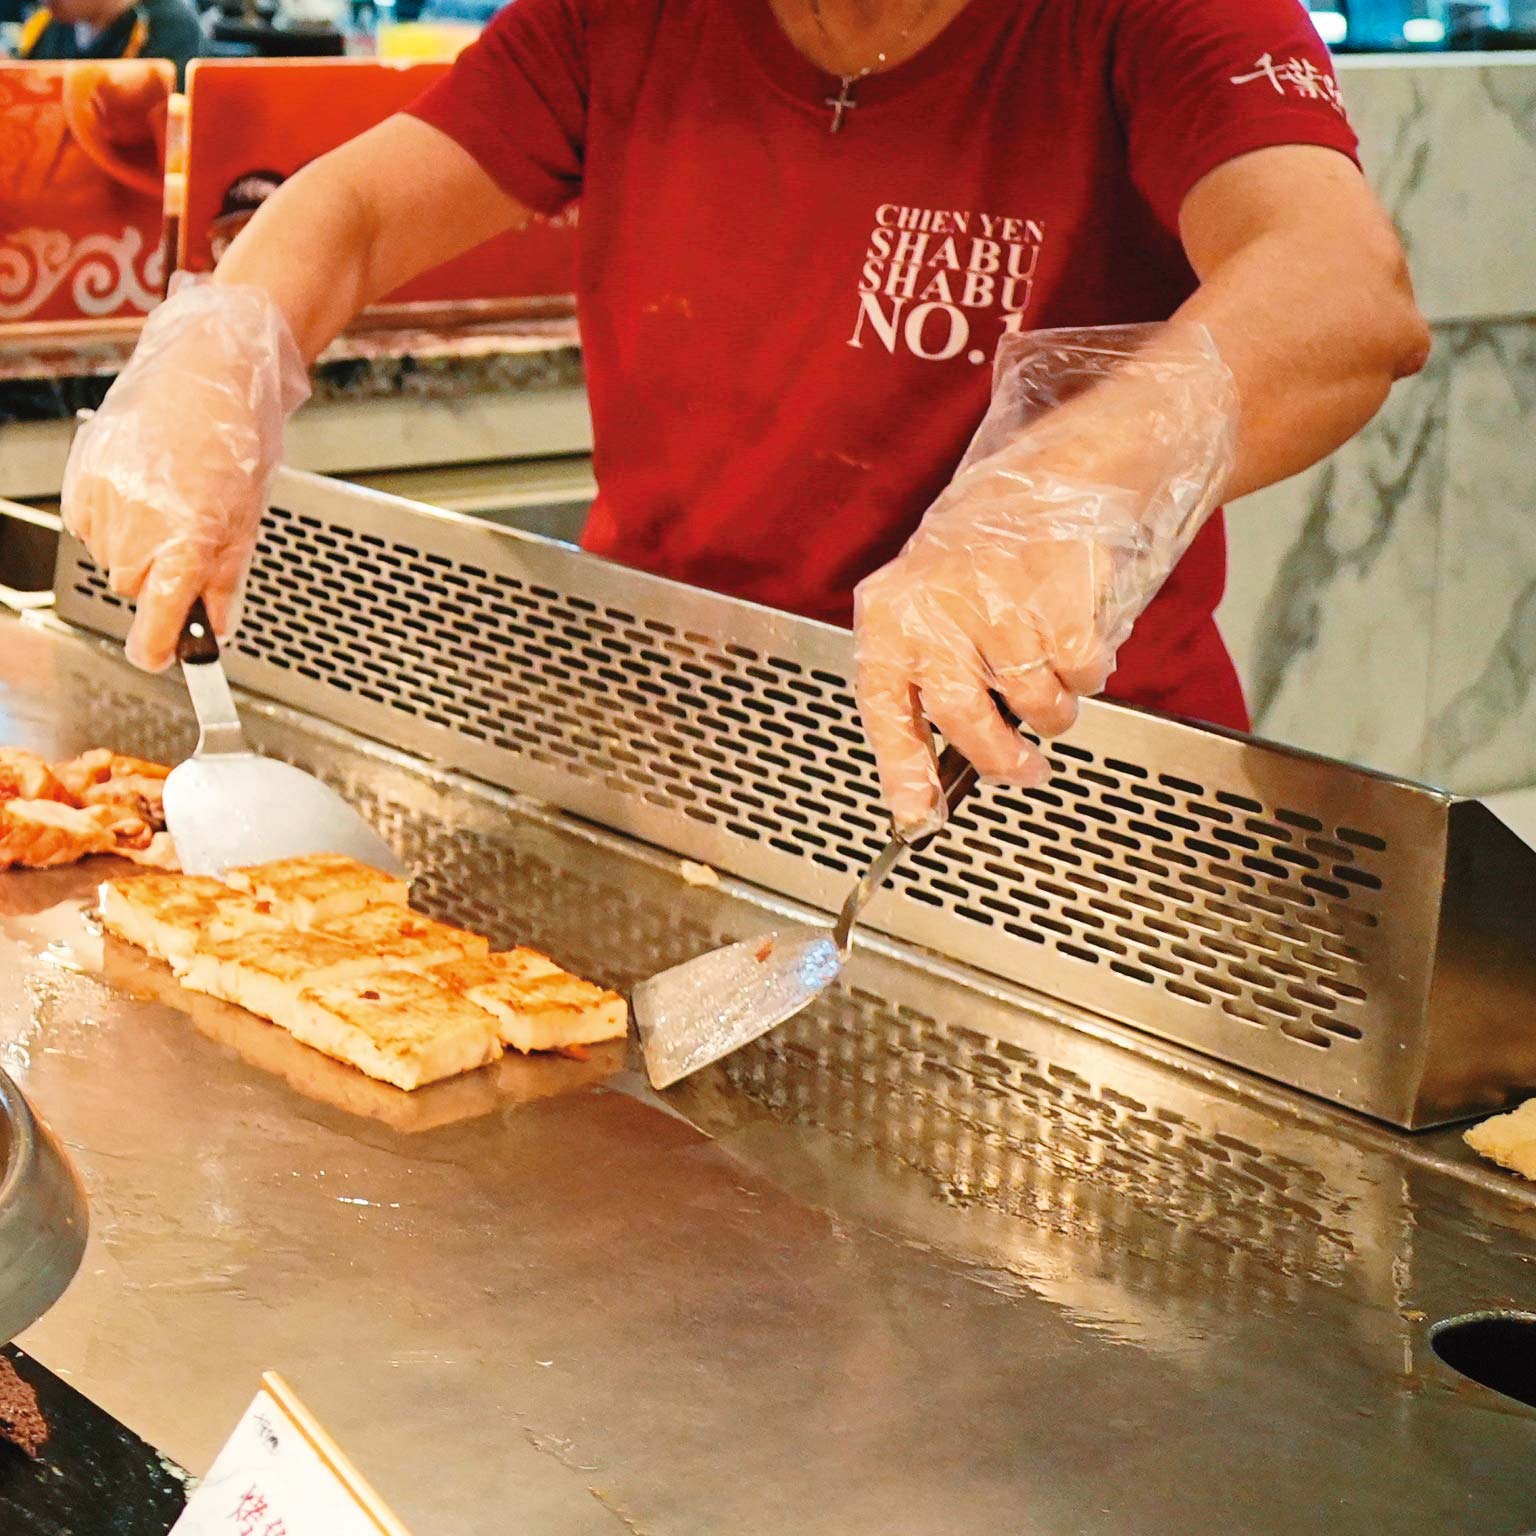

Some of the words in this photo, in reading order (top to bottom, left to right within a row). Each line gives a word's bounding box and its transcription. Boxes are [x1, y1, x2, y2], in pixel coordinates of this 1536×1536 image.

[874, 203, 971, 234] CHIEN
[979, 213, 1046, 244] YEN
[865, 227, 1041, 279] SHABU
[857, 258, 1034, 313] SHABU
